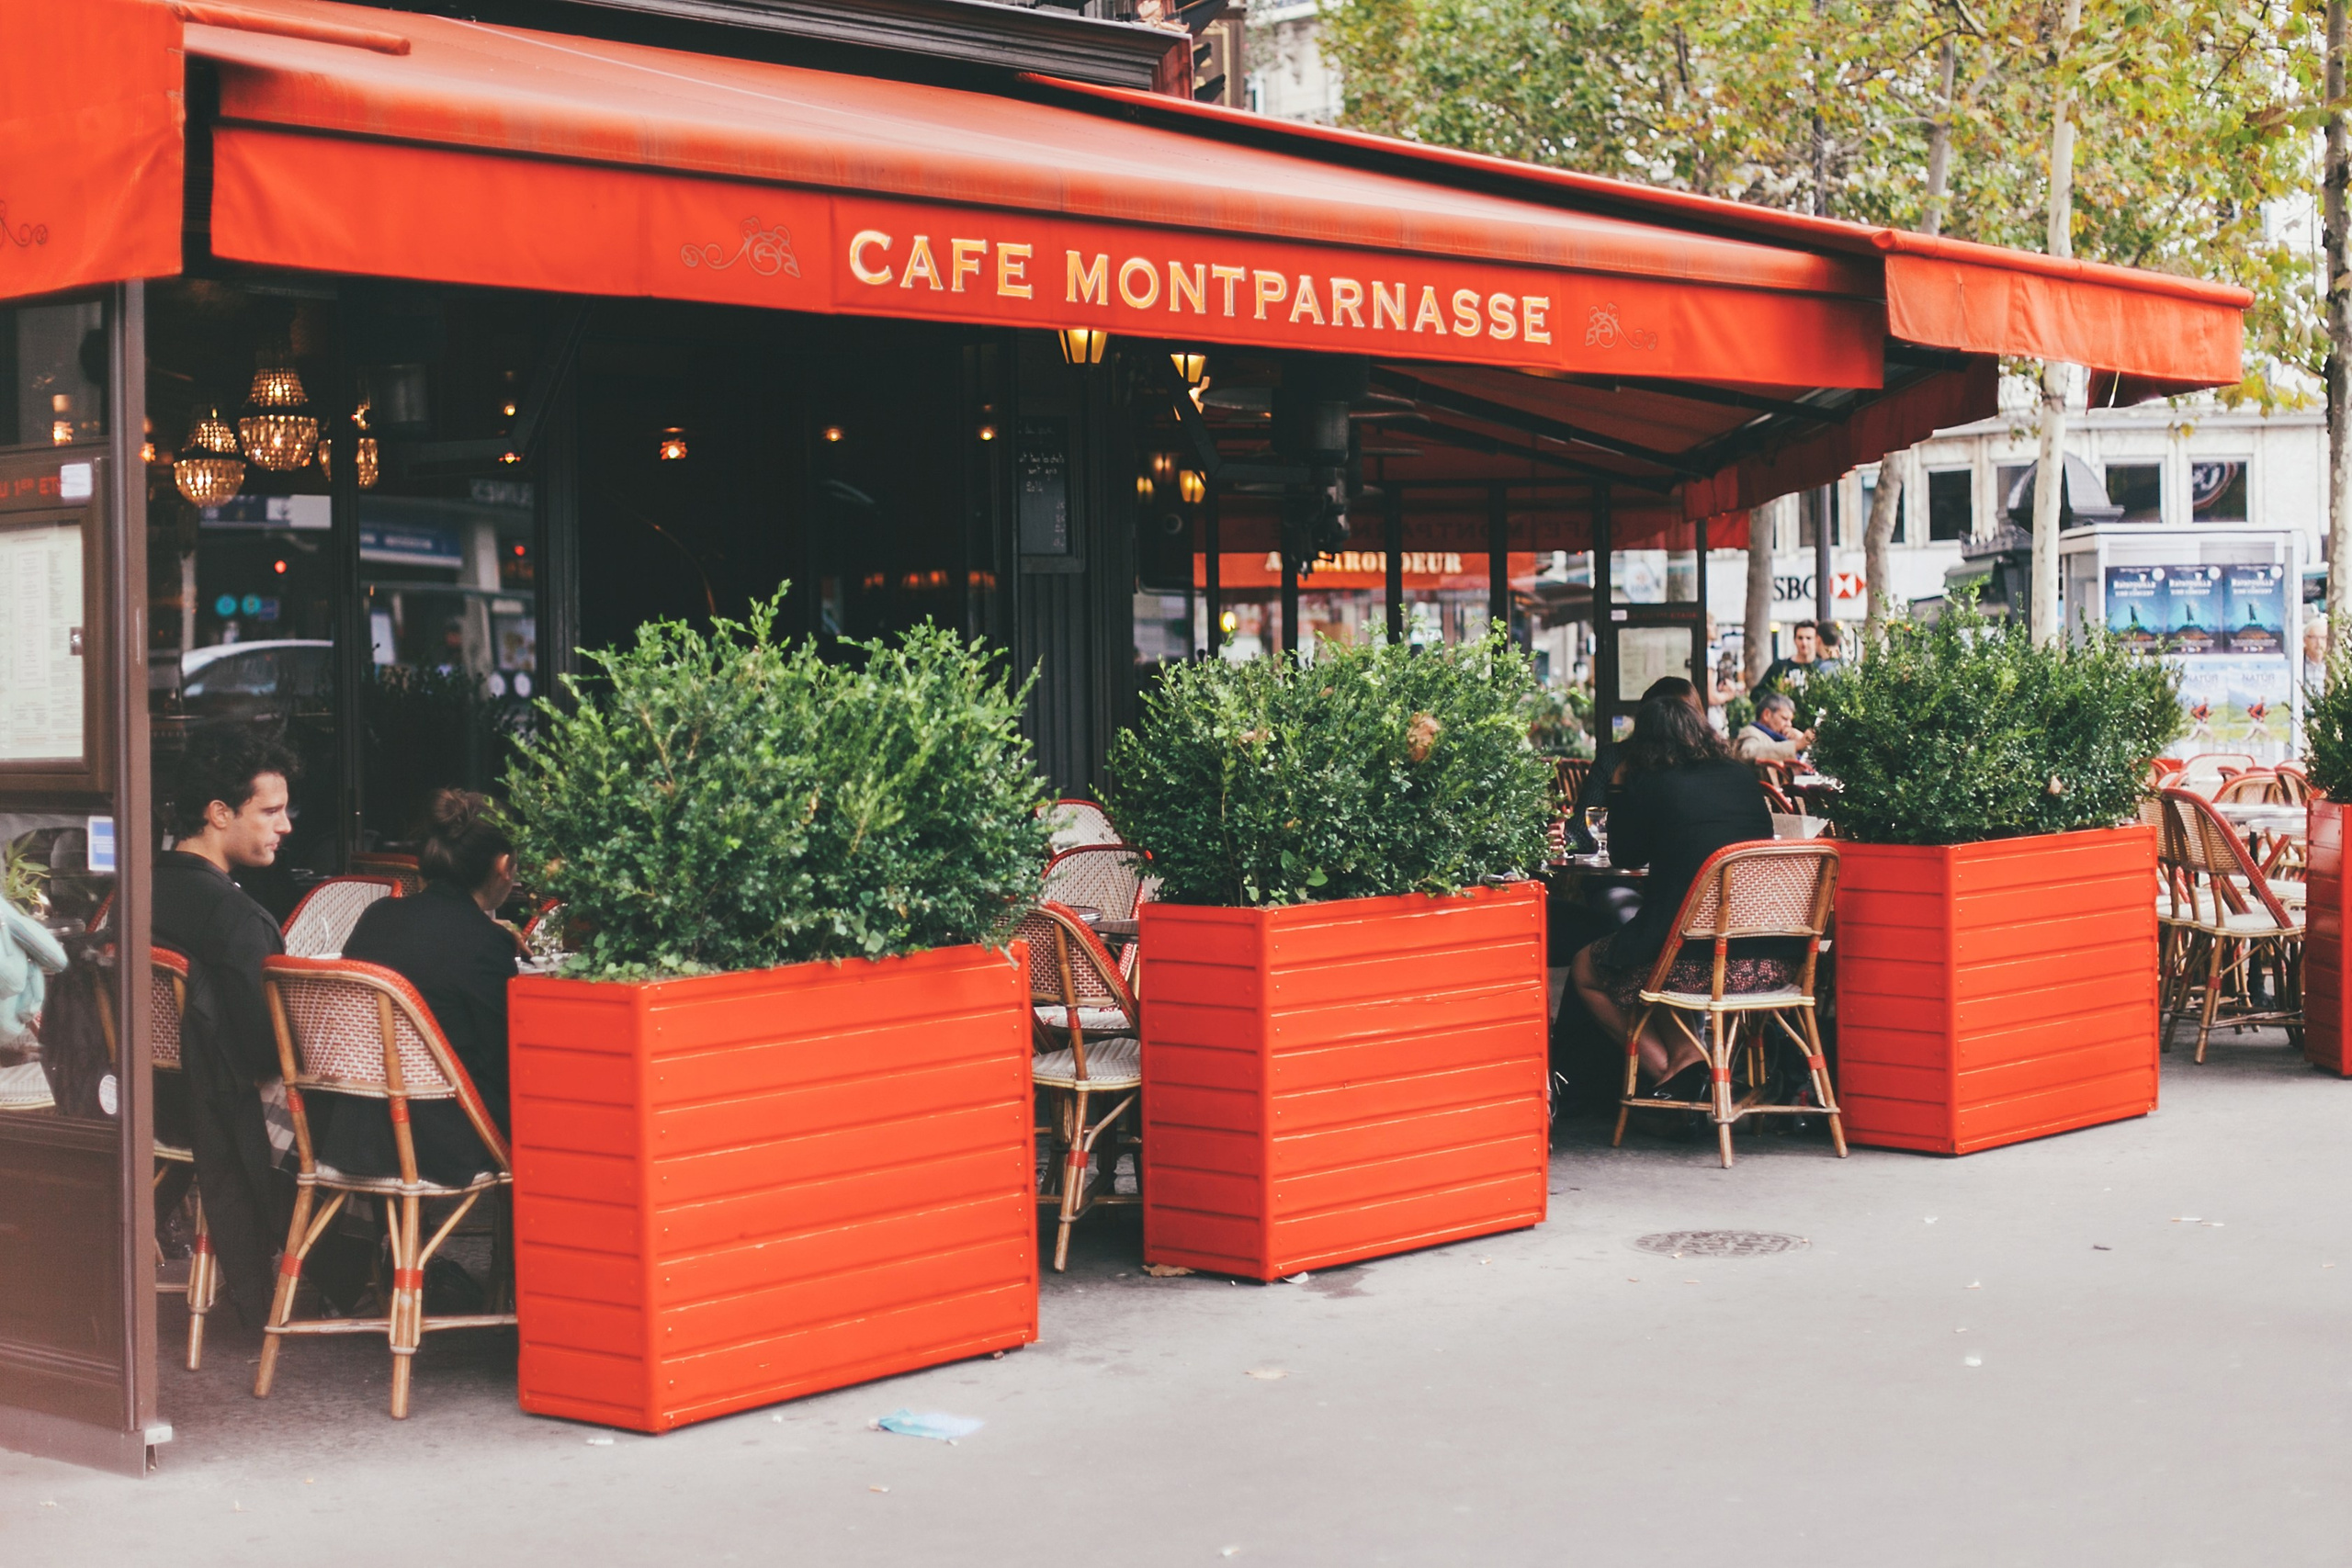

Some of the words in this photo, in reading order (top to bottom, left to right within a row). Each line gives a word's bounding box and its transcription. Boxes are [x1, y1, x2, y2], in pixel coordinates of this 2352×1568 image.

[849, 230, 1034, 299] CAFE
[1066, 250, 1552, 344] MONTPARNASSE
[1773, 575, 1816, 602] SBC
